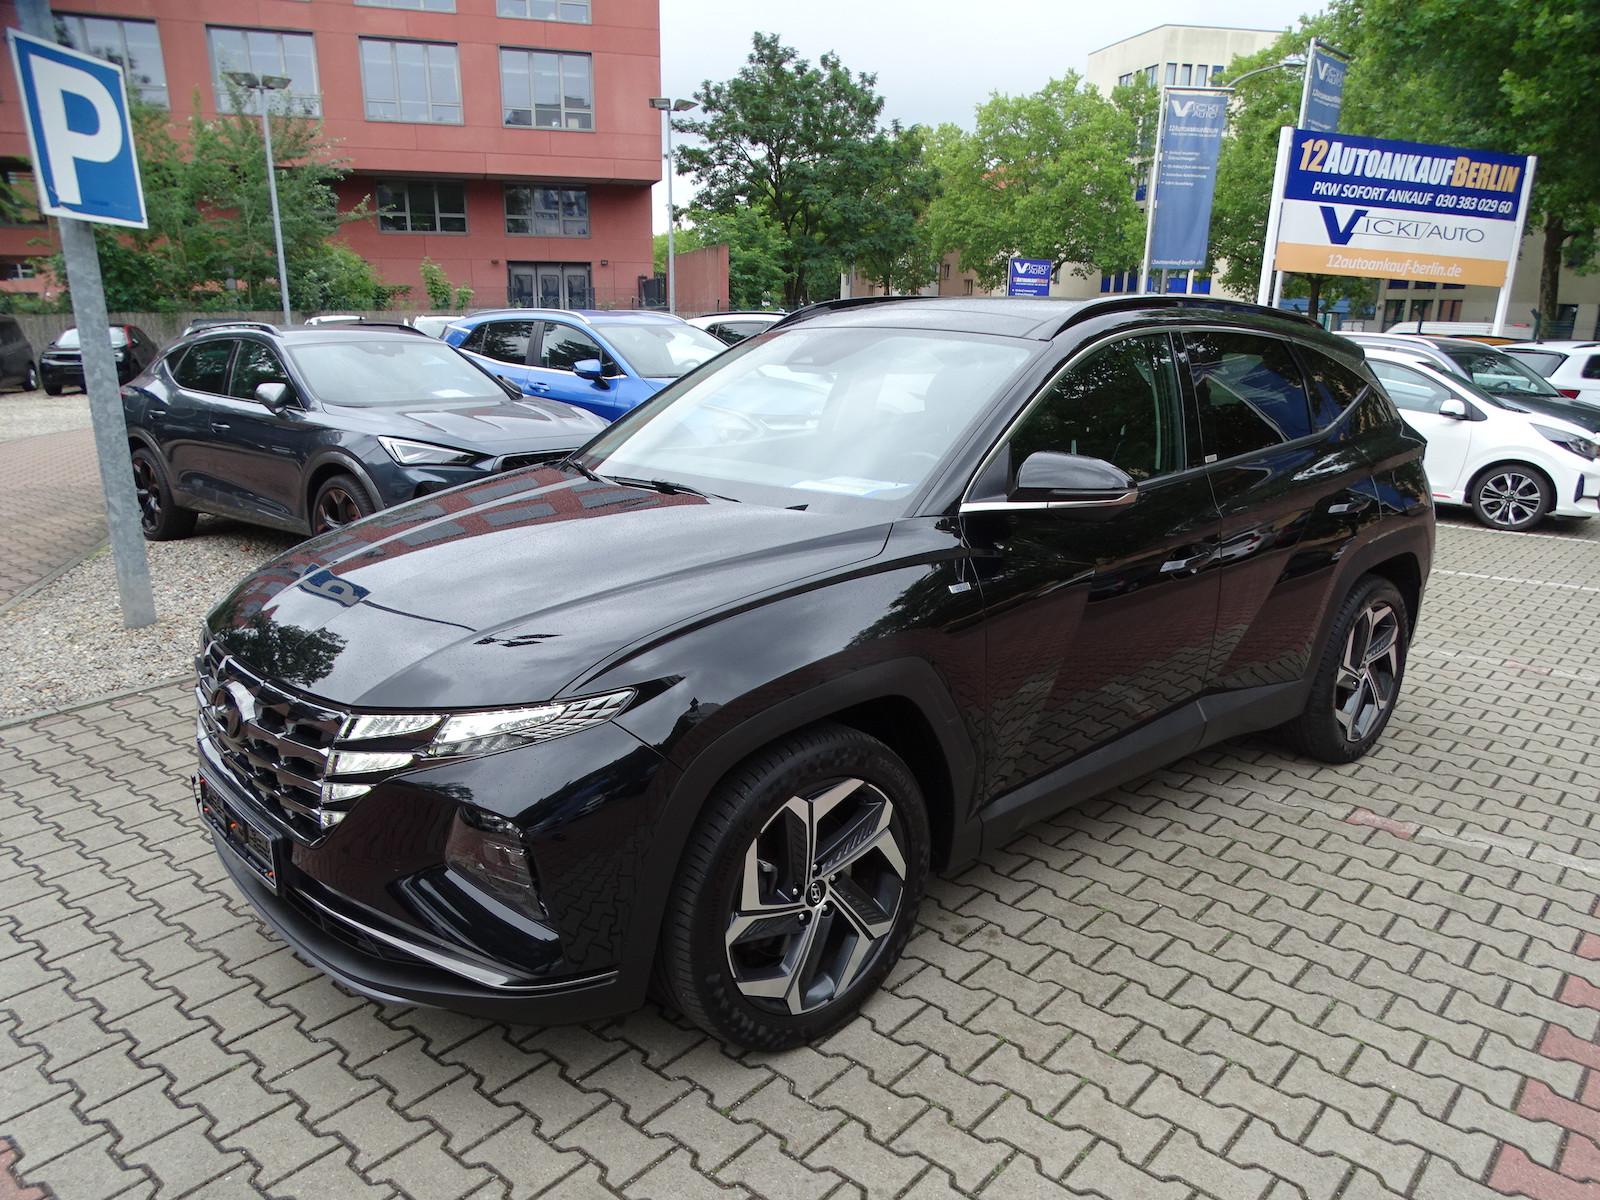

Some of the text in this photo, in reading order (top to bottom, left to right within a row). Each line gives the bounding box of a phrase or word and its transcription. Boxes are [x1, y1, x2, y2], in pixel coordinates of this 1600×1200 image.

[28, 53, 123, 205] P
[1312, 181, 1513, 214] PKW SOFORT ANKAUF 030 383 029 60
[1326, 254, 1462, 278] 12autoankauf-berlin.de
